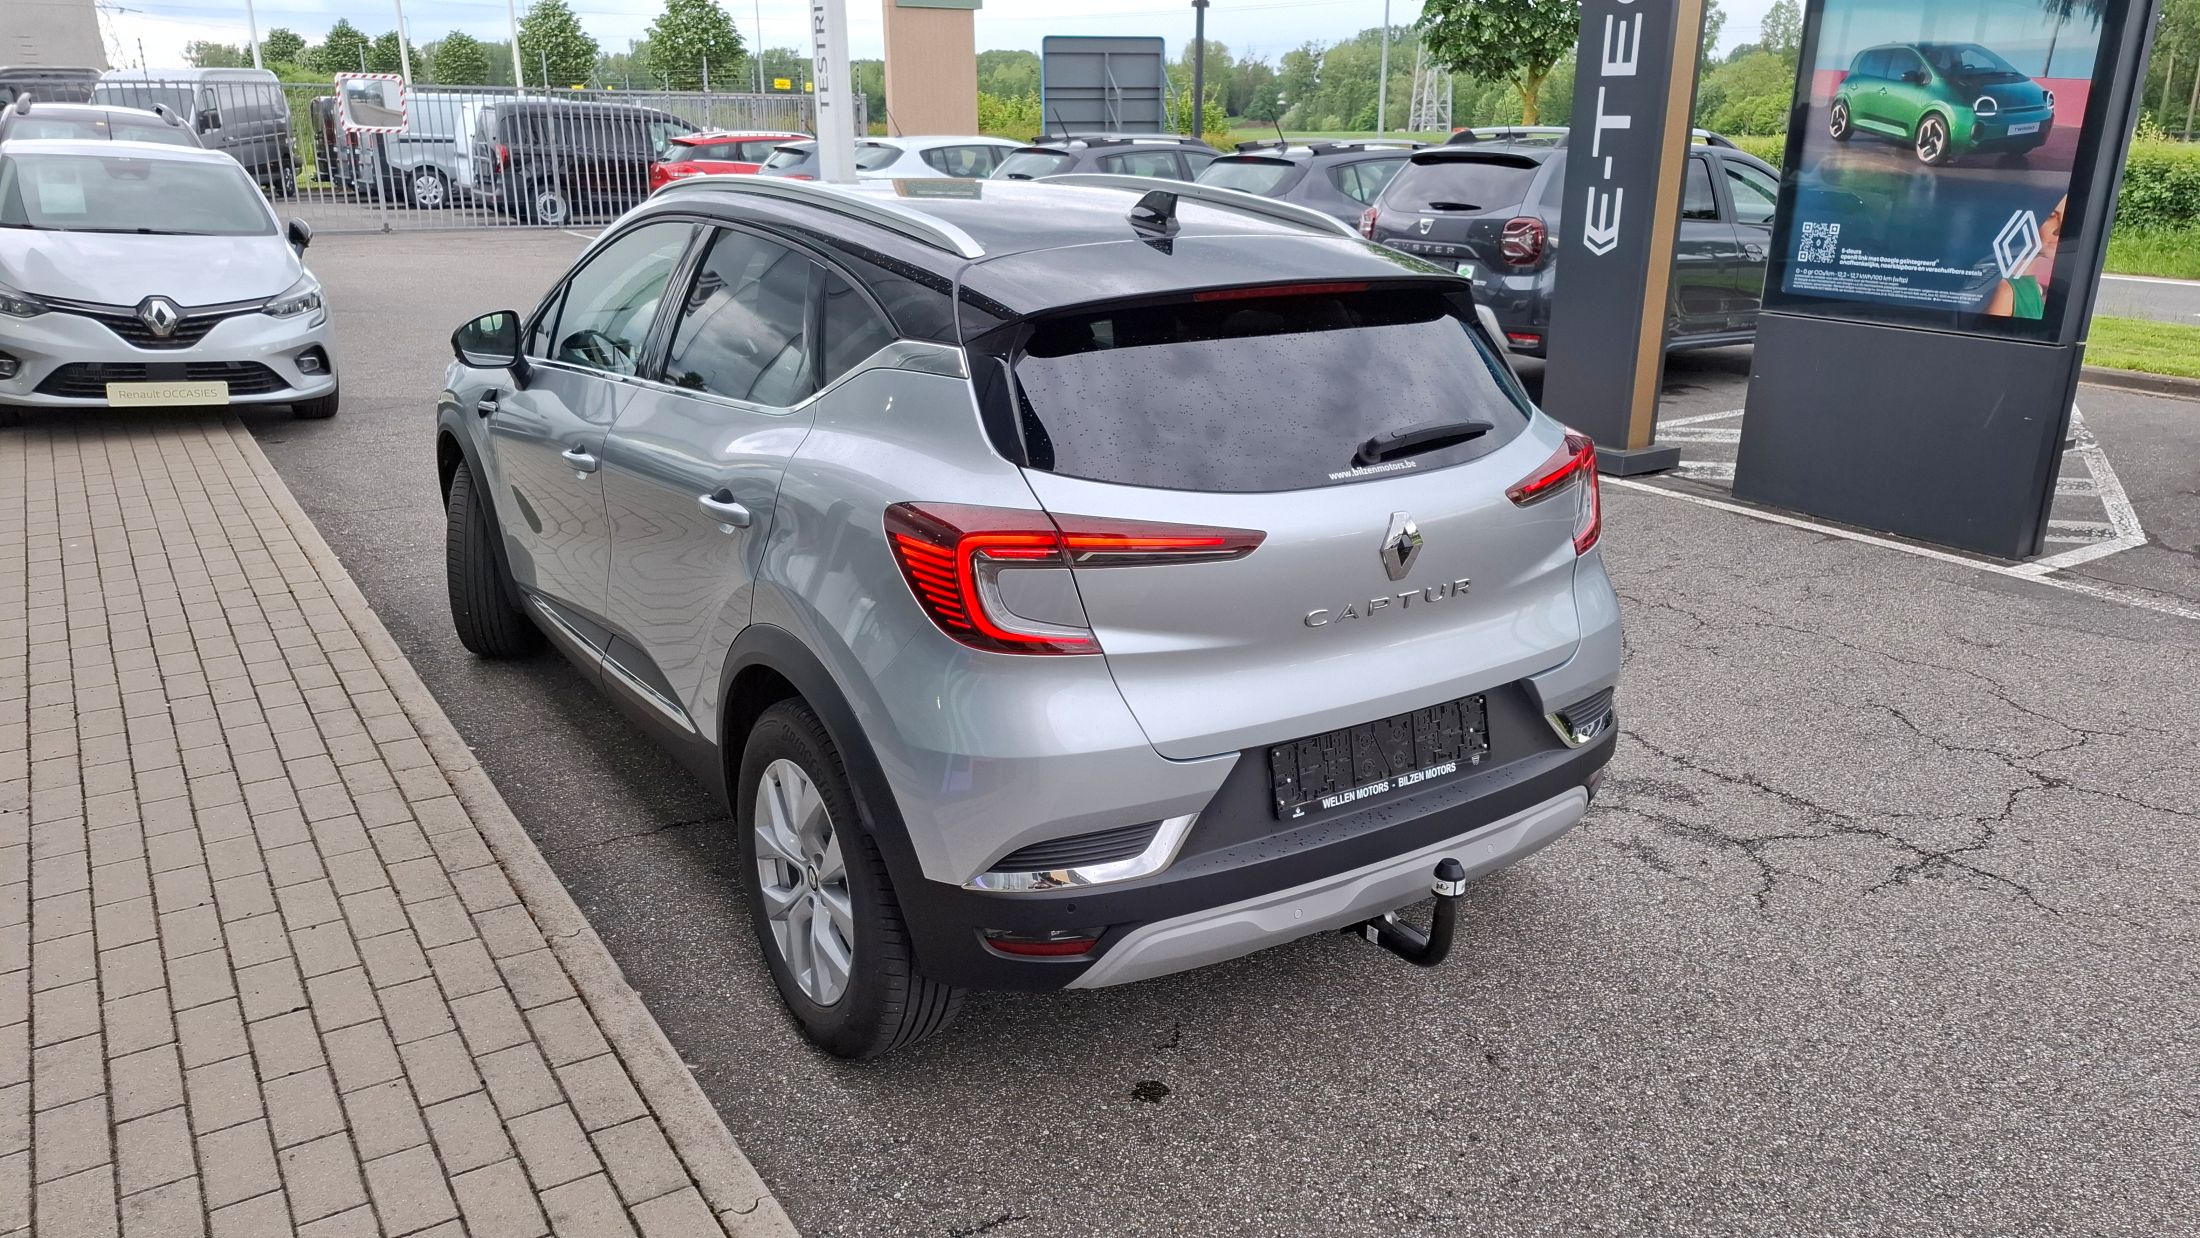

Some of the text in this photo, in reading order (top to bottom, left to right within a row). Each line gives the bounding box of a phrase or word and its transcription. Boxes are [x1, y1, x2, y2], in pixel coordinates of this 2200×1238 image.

[813, 0, 829, 114] TESTRI
[1584, 0, 1642, 256] E-TE
[118, 388, 218, 399] Renault OCCASIES
[1328, 459, 1417, 480] www.bilzenmotors.be
[1303, 578, 1473, 628] CAPTUR
[1322, 790, 1356, 809] WELLEN
[1356, 781, 1389, 800] MOTORS
[1398, 771, 1425, 788] BILZEN
[1425, 762, 1457, 780] MOTORS
